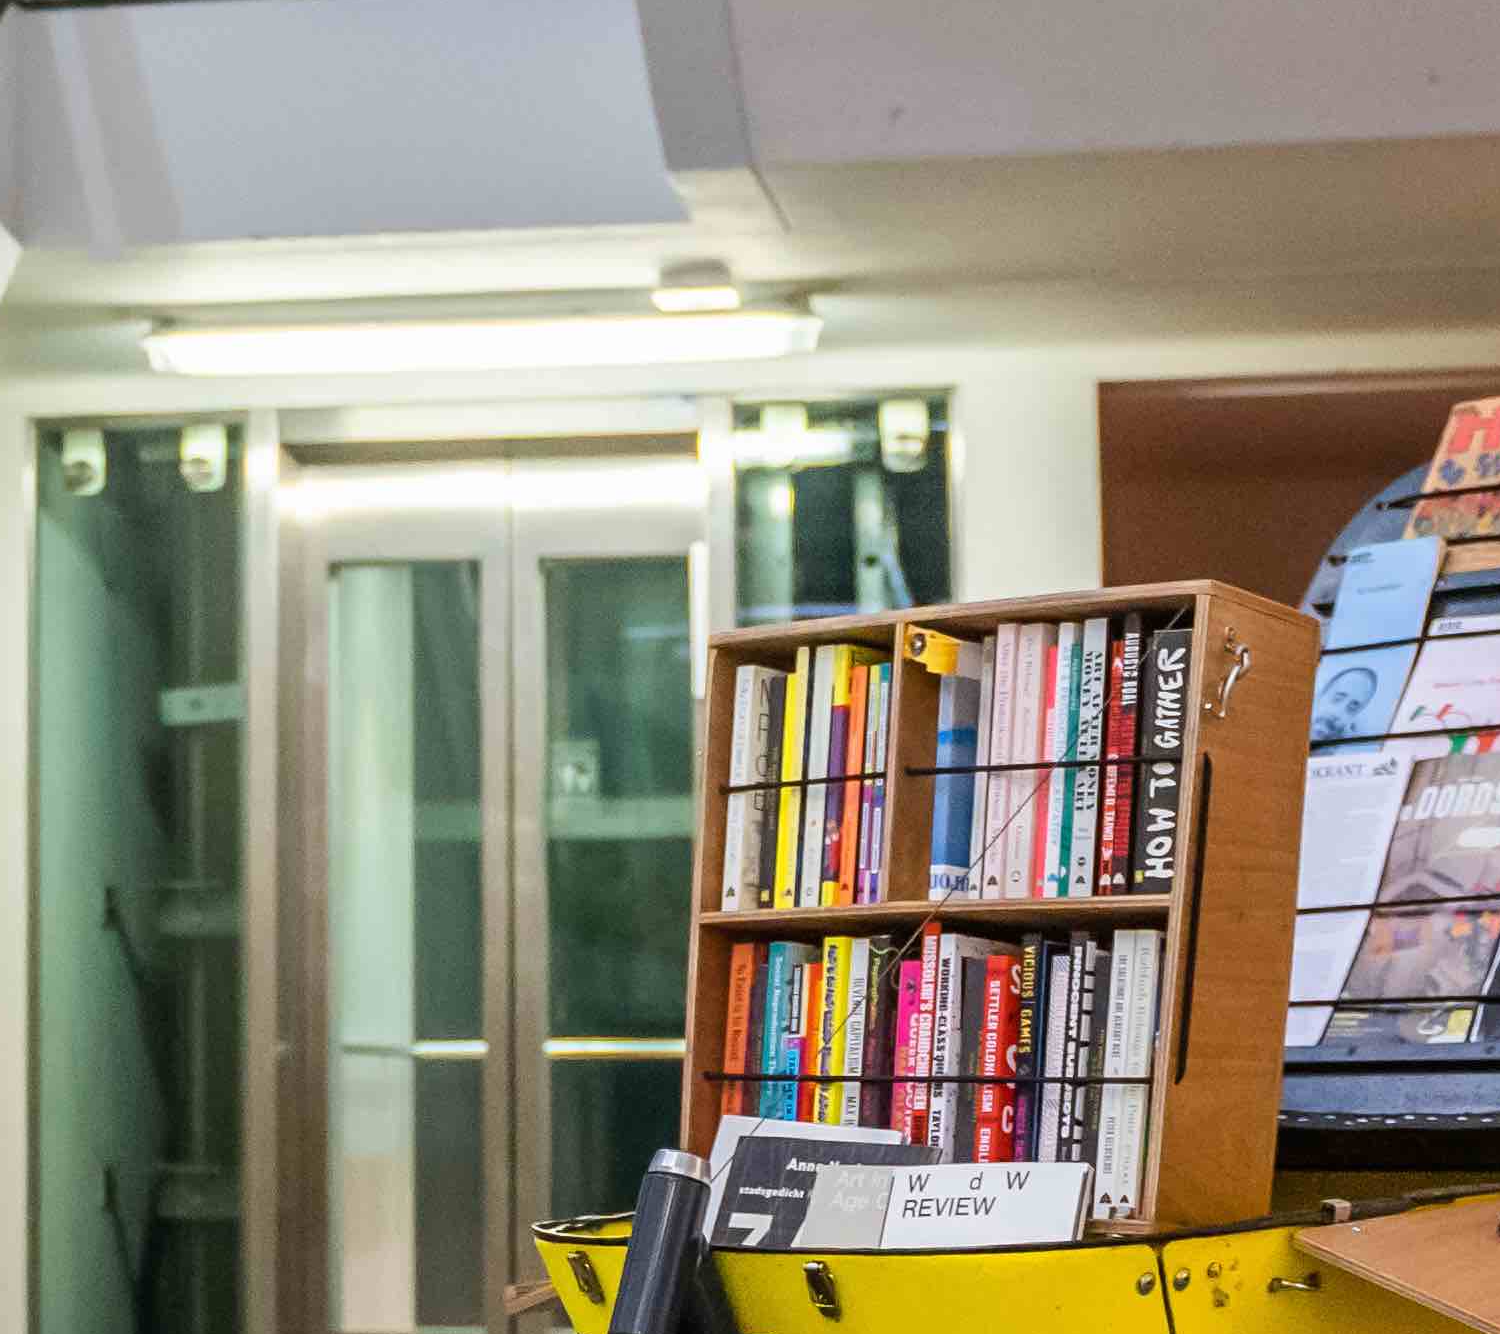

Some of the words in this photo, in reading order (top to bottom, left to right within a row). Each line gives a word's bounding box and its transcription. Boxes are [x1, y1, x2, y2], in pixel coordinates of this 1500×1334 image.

[1153, 647, 1186, 749] GATHER
[1149, 763, 1177, 798] TO
[1145, 809, 1176, 879] HOW
[919, 935, 938, 1011] MUSSOLINI'S
[1020, 945, 1036, 998] VICIOUS
[1068, 945, 1083, 1038] INNOCENT
[936, 957, 950, 1052] WORKING-CLASS
[988, 979, 1001, 1030] SETTLER
[847, 1021, 861, 1074] CAPITALISM
[1019, 1008, 1033, 1053] GAMES
[933, 1055, 947, 1098] QUERS
[982, 1032, 998, 1113] COLONILISM
[1061, 1041, 1078, 1139] SUBECTS
[846, 1095, 858, 1115] MAX
[738, 1185, 805, 1201] stadsgedicht
[832, 1191, 869, 1211] Age
[835, 1170, 865, 1188] Art
[908, 1173, 931, 1192] W
[969, 1171, 983, 1191] d
[1005, 1171, 1030, 1190] W
[902, 1196, 997, 1218] REVIEW
